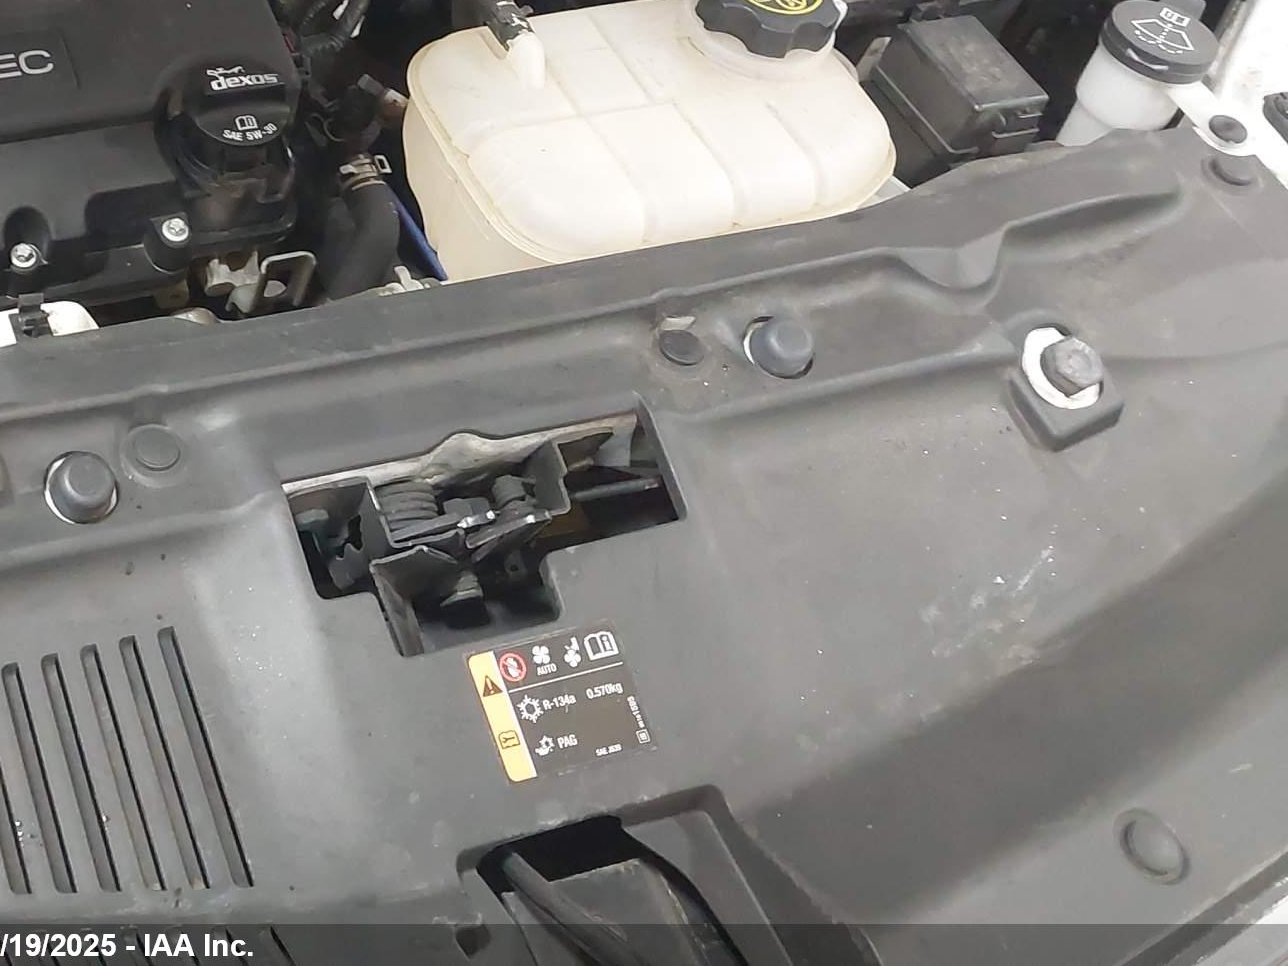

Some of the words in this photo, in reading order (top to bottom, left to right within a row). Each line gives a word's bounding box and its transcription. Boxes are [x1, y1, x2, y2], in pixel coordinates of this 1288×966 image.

[210, 73, 279, 91] dexos
[222, 129, 244, 141] SAE
[245, 122, 278, 141] 5W-30
[536, 663, 557, 676] AUTO
[542, 695, 577, 710] R-134a
[585, 682, 624, 700] 0.570kg
[557, 733, 579, 749] PAG
